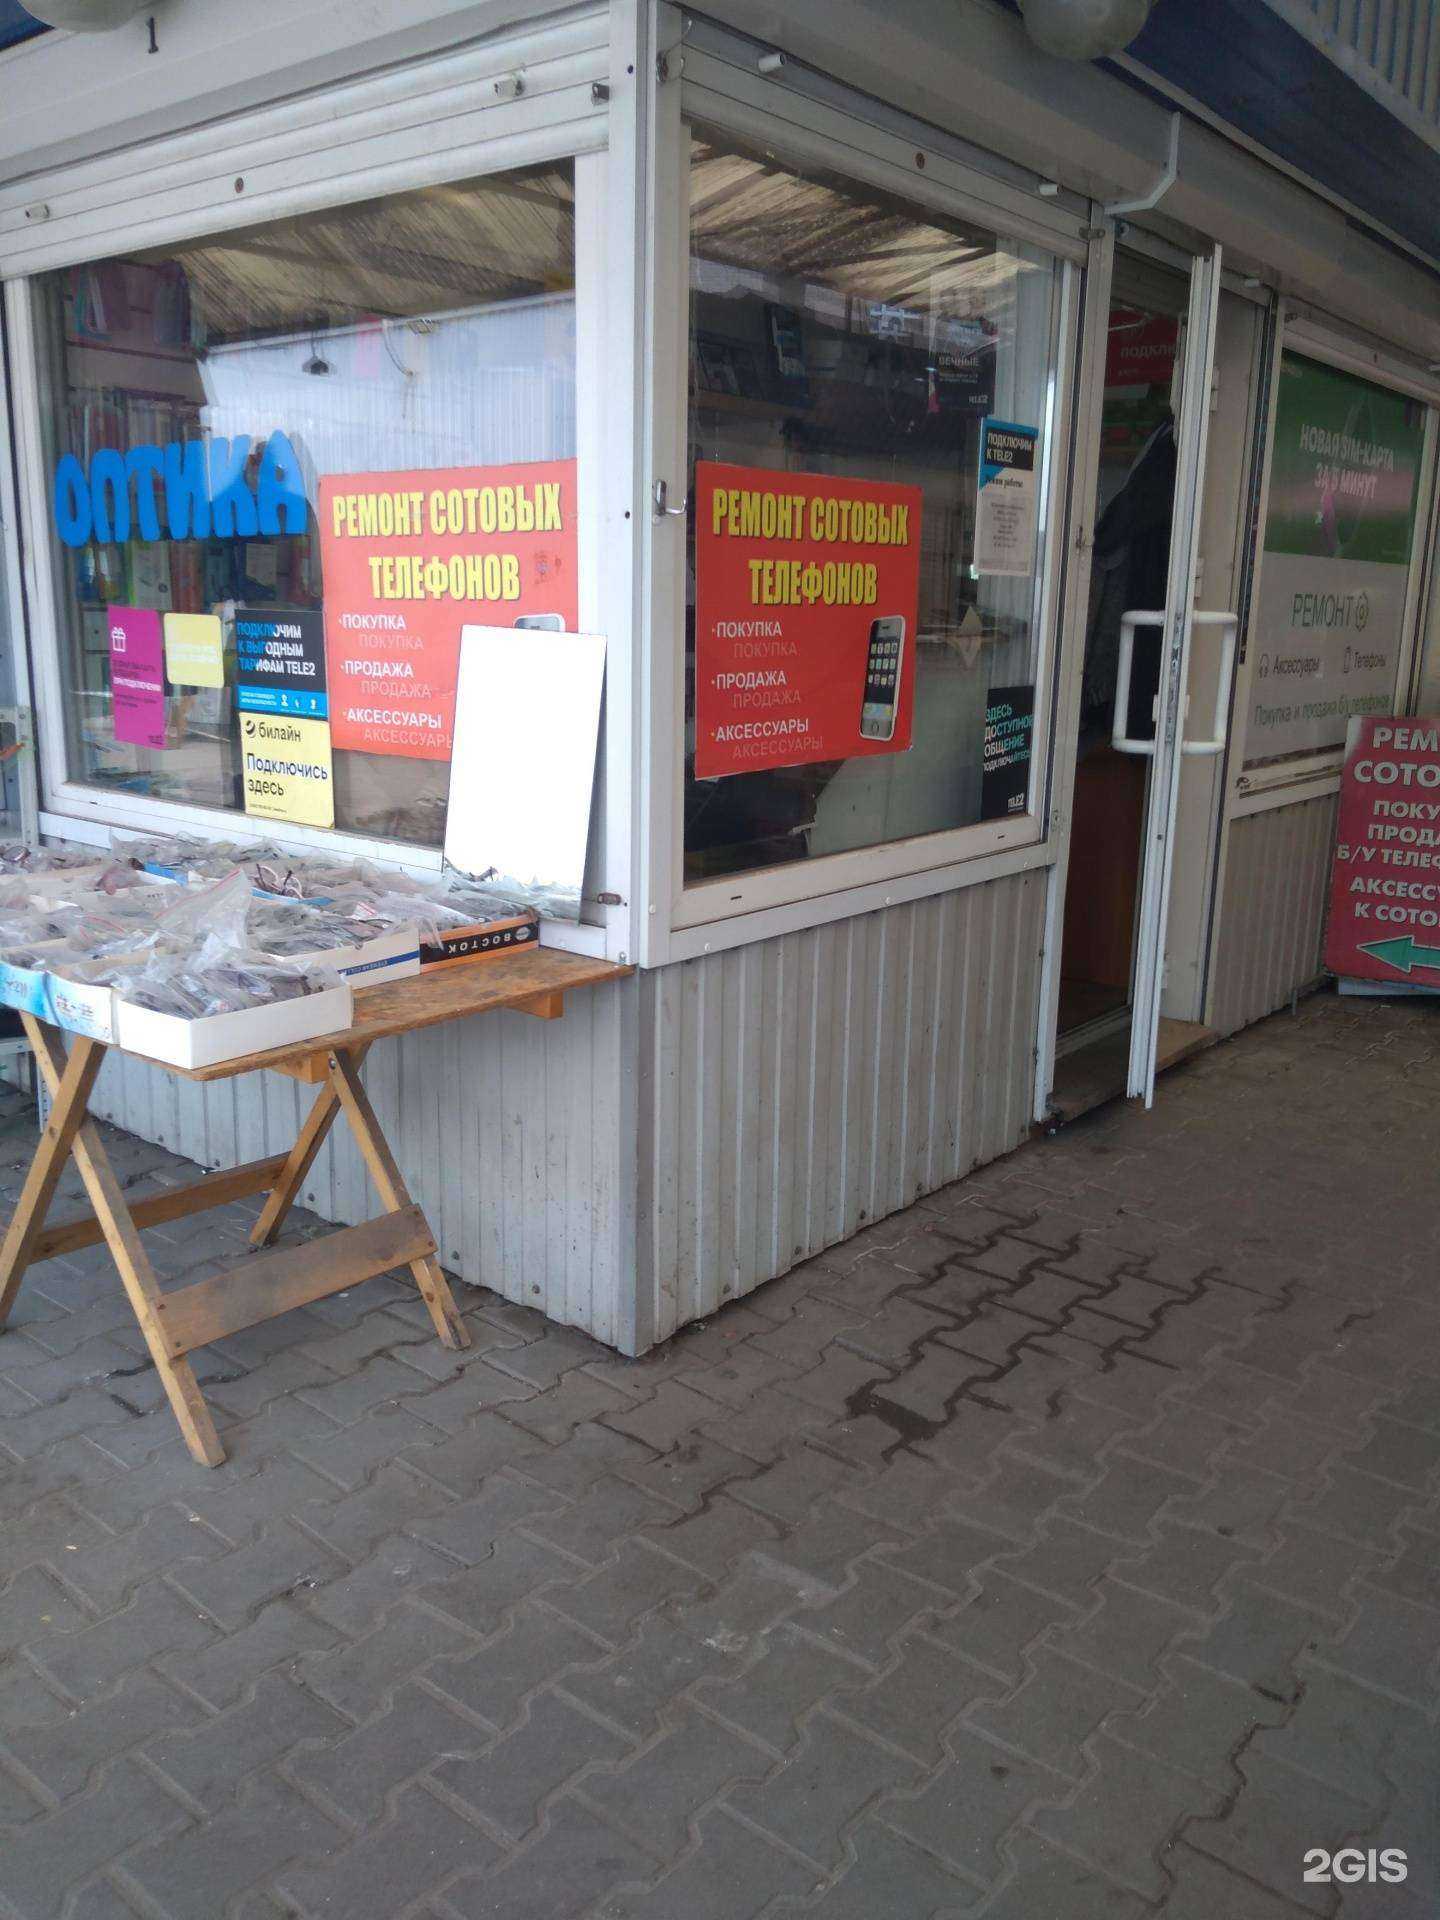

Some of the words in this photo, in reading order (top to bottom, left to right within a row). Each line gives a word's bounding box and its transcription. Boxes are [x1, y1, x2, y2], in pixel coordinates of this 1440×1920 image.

[54, 429, 308, 549] ОПТИКА
[332, 491, 425, 537] РЕМОНТ
[429, 483, 563, 535] СОТОВЫХ
[712, 488, 806, 541] РЕМОНТ
[809, 496, 909, 545] СОТОВЫХ
[368, 554, 521, 601] ТЕЛЕФОНОВ
[748, 559, 878, 605] ТЕЛЕФОНОВ
[1291, 593, 1355, 628] РЕМОНТ
[342, 613, 407, 630] ПОКУПКА
[716, 621, 783, 638] ПОКУПКА
[359, 633, 424, 650] ПОКУПКА
[734, 641, 799, 658] ПОКУПКА
[285, 660, 316, 676] TELE2
[345, 660, 414, 677] ПРОДАЖА
[361, 680, 432, 698] ПРОДАЖА
[716, 670, 787, 690] ПРОДАЖА
[733, 689, 801, 708] ПРОДАЖА
[346, 708, 442, 729] АКСЕССУАРЫ
[985, 704, 1012, 723] ЗДЕСЬ
[259, 722, 301, 742] билайн
[715, 718, 809, 742] АКСЕССУАРЫ
[732, 736, 824, 760] АКСЕССУАРЫ
[984, 733, 1025, 757] ОБЩЕНИЕ
[247, 752, 328, 780] Подключись
[248, 779, 285, 797] здесь
[1337, 844, 1376, 864] Б/У
[1350, 876, 1440, 900] АКСЕСС
[1354, 902, 1370, 919] К
[1375, 904, 1440, 927] СОТО
[448, 932, 511, 954] ВОСТОК
